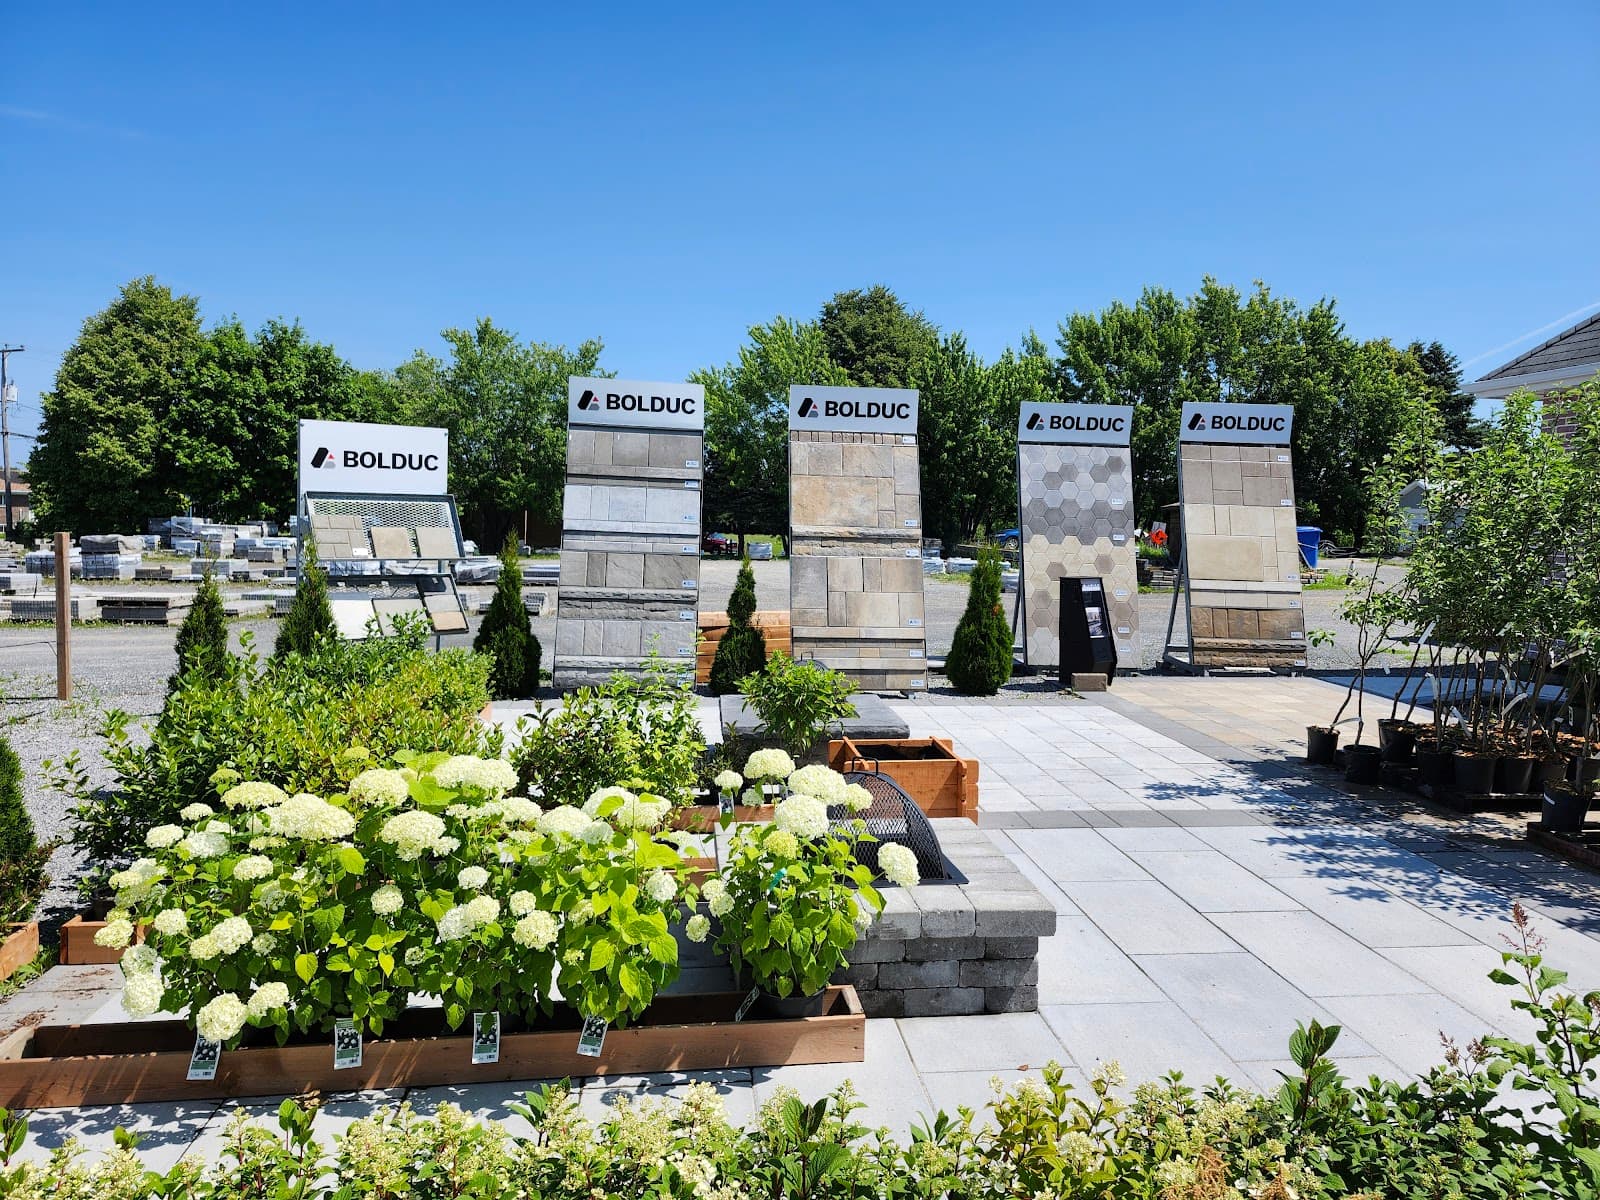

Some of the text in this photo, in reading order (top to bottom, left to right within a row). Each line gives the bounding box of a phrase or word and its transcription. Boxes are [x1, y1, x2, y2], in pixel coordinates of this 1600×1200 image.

[606, 393, 695, 414] BOLDUC
[824, 400, 909, 418] BOLDUC
[1049, 415, 1123, 431] BOLDUC
[1211, 415, 1285, 431] BOLDUC
[343, 450, 438, 471] BOLDUC
